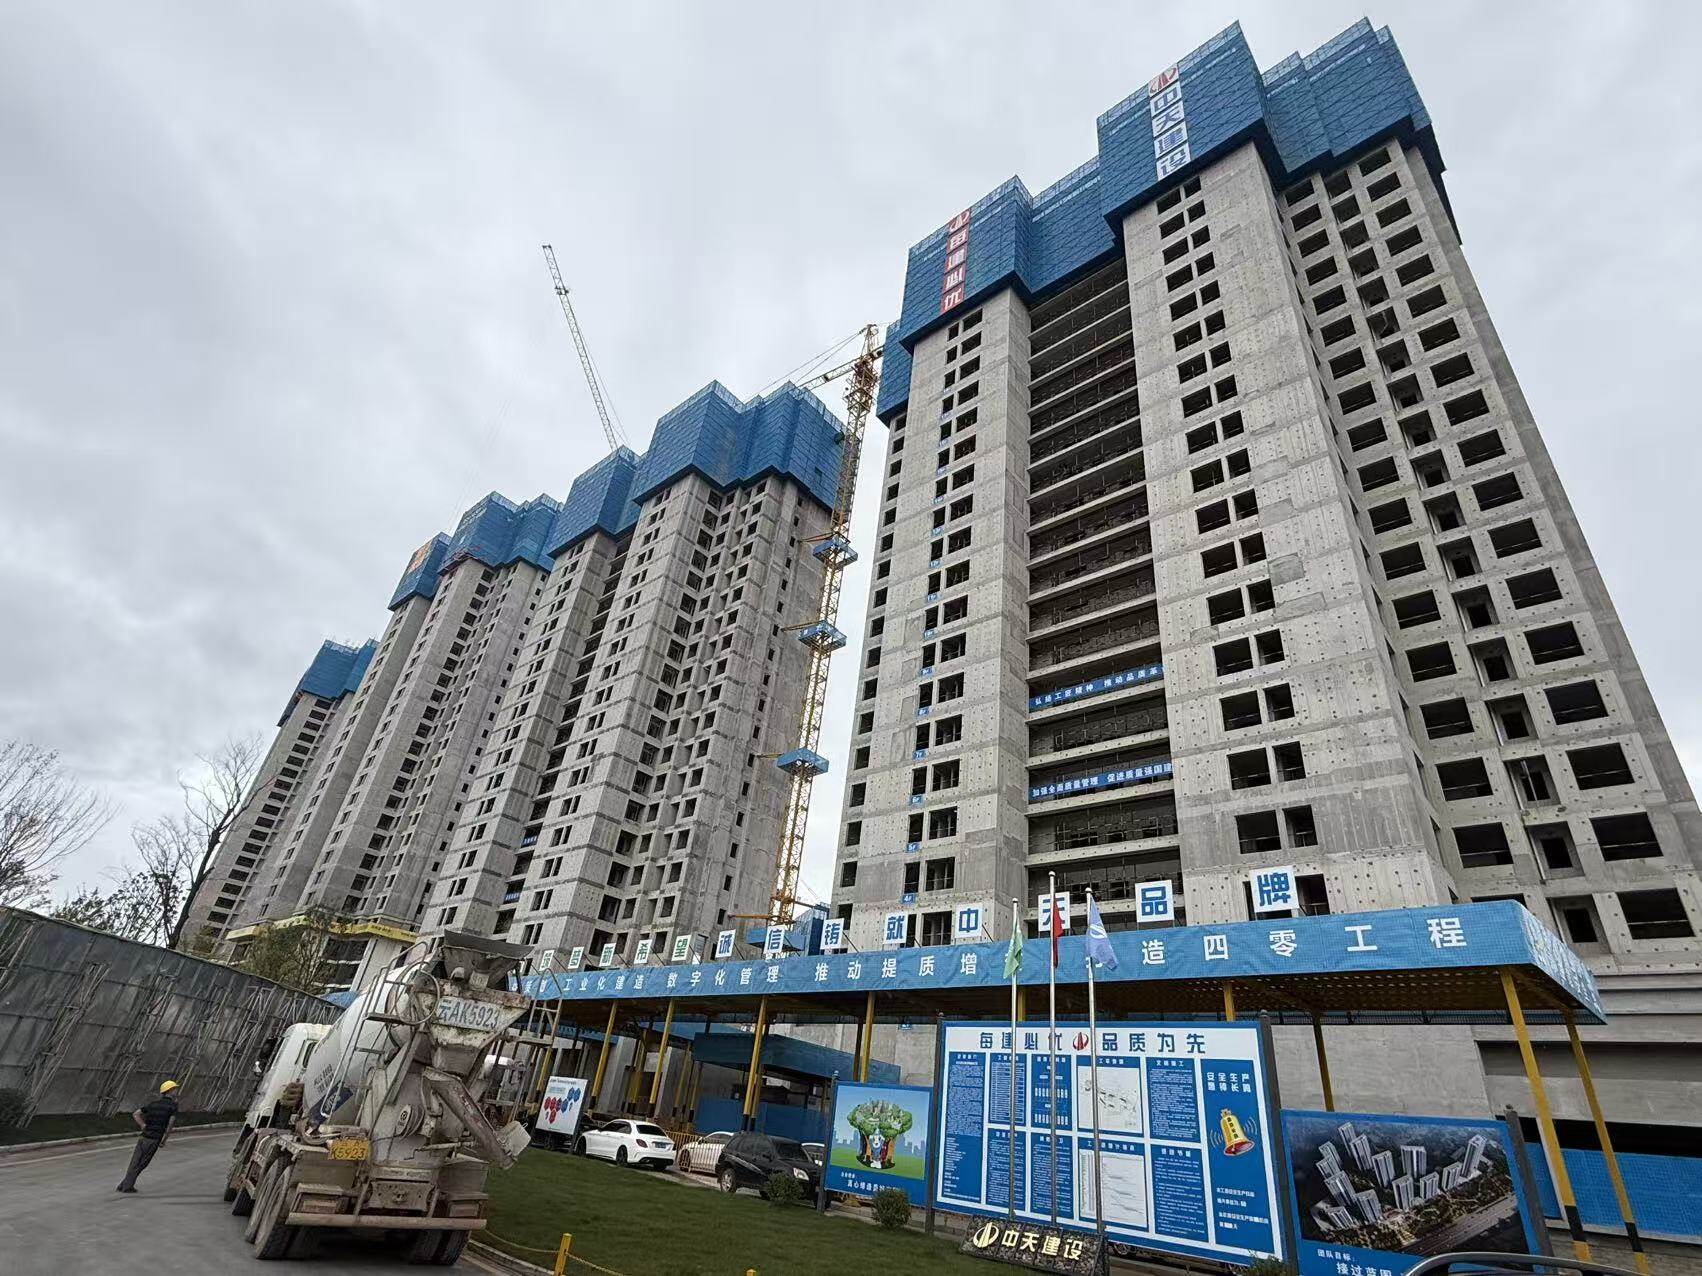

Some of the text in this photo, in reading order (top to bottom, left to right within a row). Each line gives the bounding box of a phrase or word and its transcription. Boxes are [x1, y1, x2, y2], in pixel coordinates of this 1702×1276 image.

[1154, 87, 1187, 177] 中天建设
[1035, 665, 1164, 705] 弘扬工匠精神 推动品质革
[1032, 776, 1099, 798] 加强全面质量管理
[667, 966, 779, 988] 数字化管理
[815, 952, 1021, 981] 推动提质增
[1085, 917, 1467, 968] 造四零工程
[1102, 1032, 1206, 1054] 品质为先
[1206, 1072, 1250, 1082] 安全生产
[1001, 1230, 1083, 1260] 中天建设
